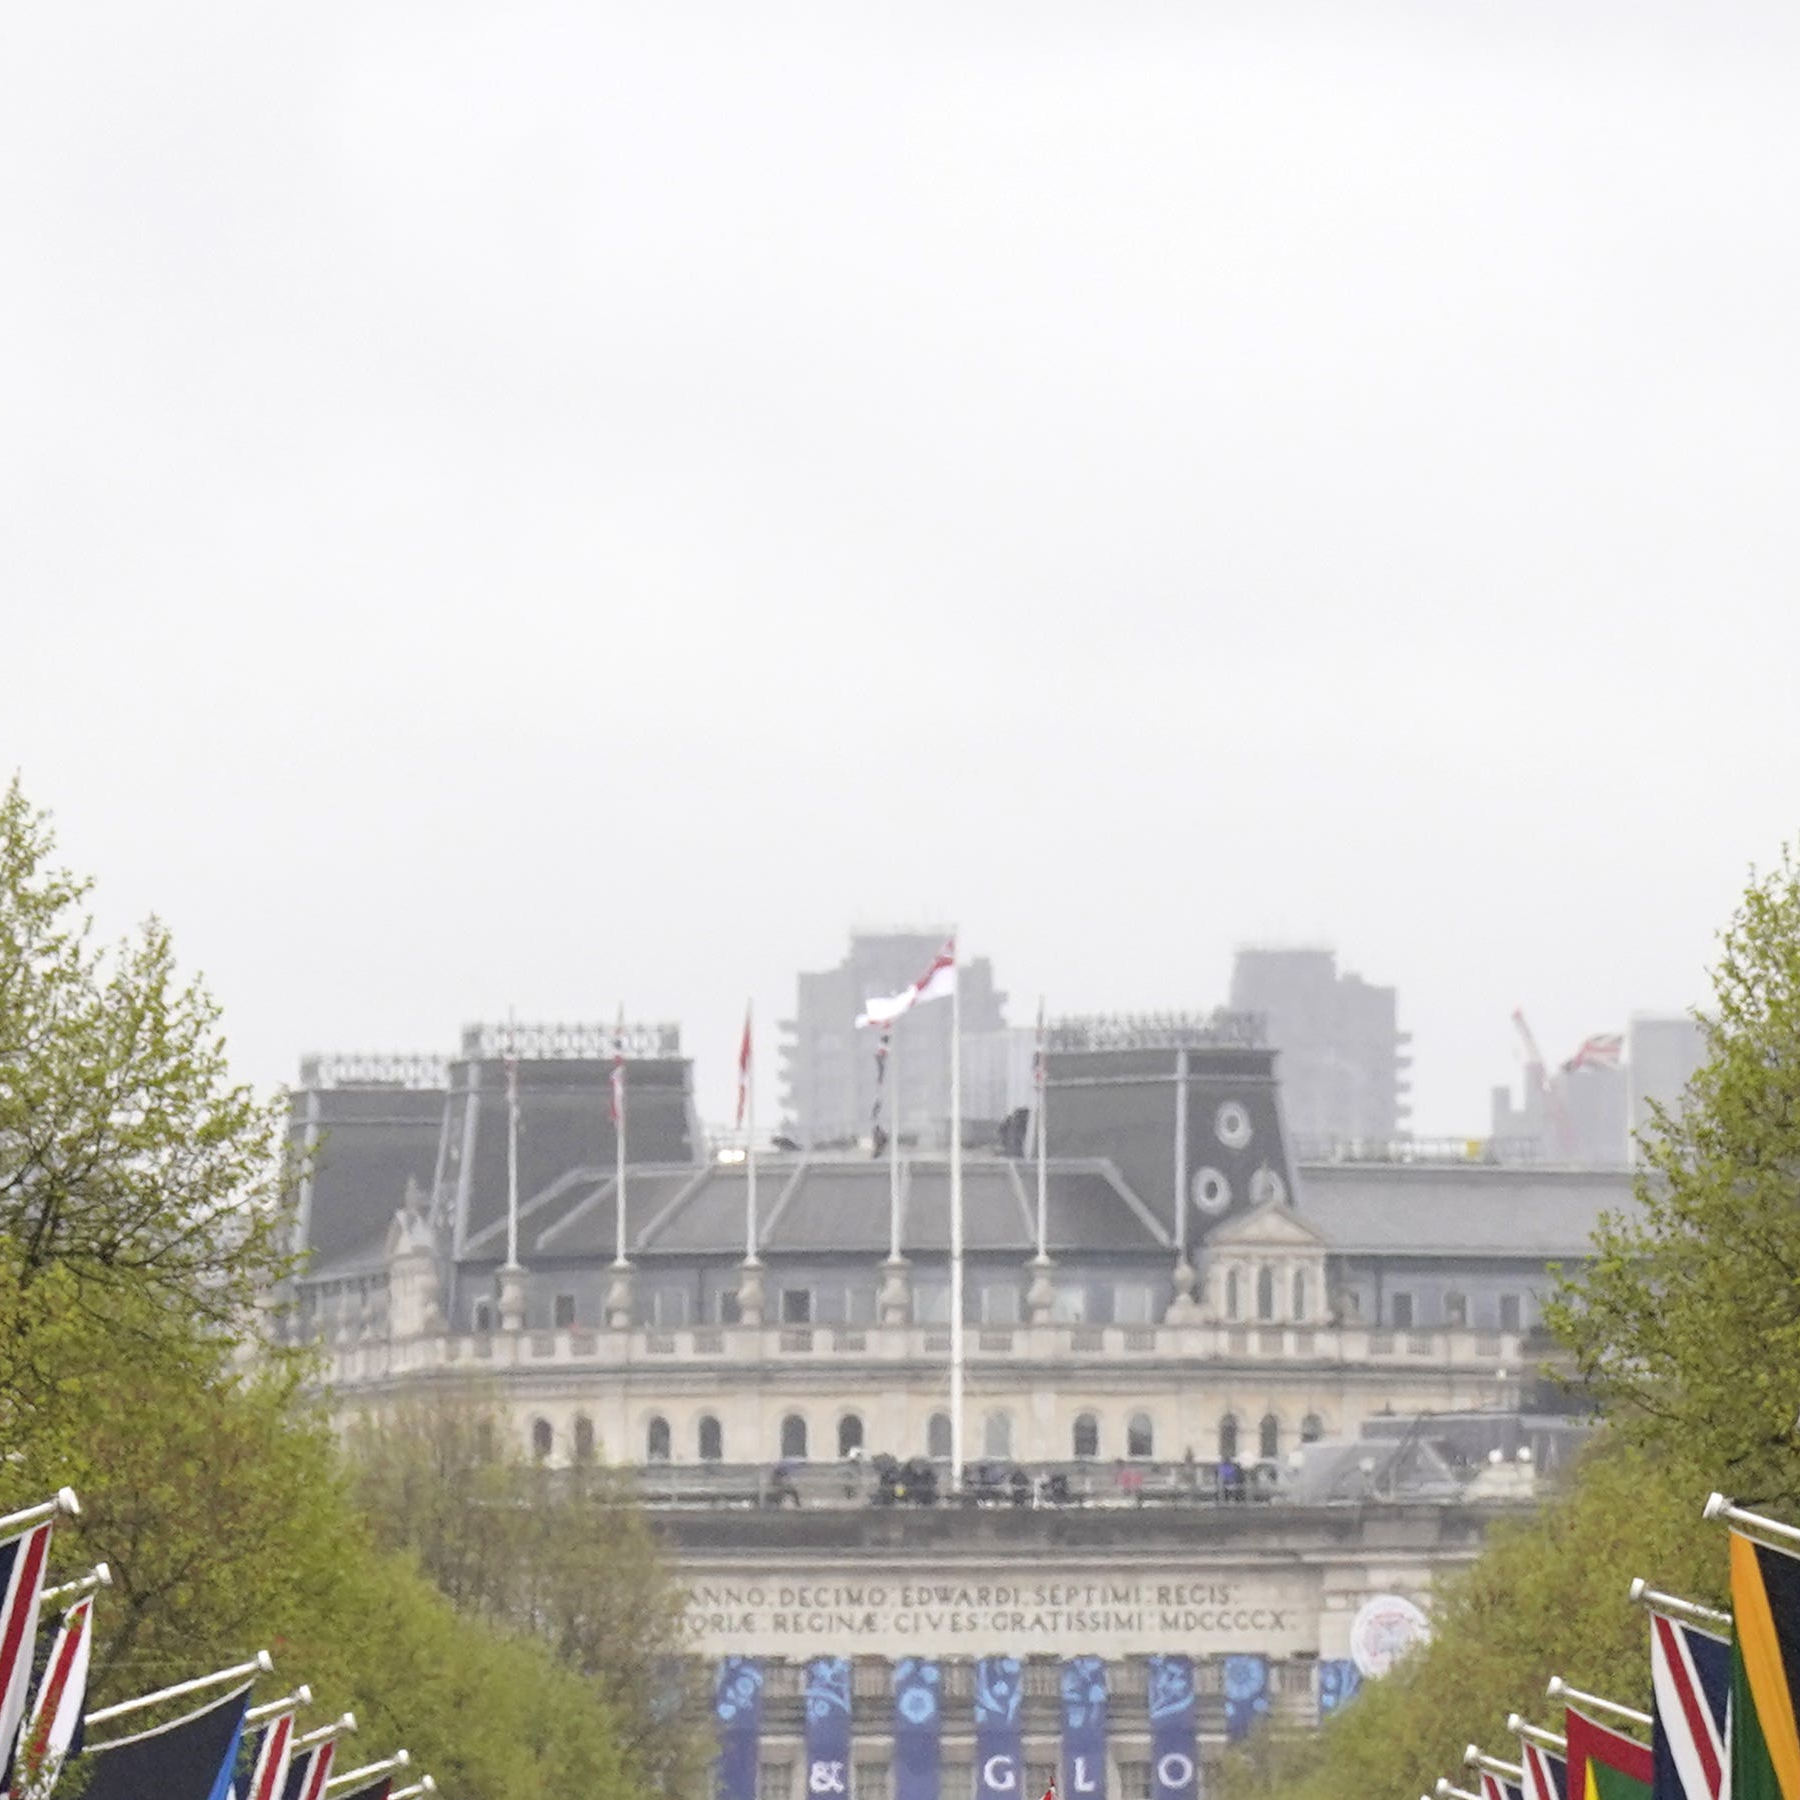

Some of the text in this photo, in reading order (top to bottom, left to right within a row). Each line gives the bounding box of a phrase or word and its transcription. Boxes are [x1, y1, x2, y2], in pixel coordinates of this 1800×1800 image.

[779, 1586, 887, 1609] DECIMO
[902, 1585, 1019, 1609] EDWARDI
[1033, 1584, 1142, 1608] SEPTIMI
[1157, 1584, 1232, 1607] REGIS
[893, 1611, 978, 1633] CIVES
[991, 1610, 1143, 1633] GRATISSIMI
[1159, 1610, 1286, 1632] MDCCCCX
[809, 1761, 845, 1794] &
